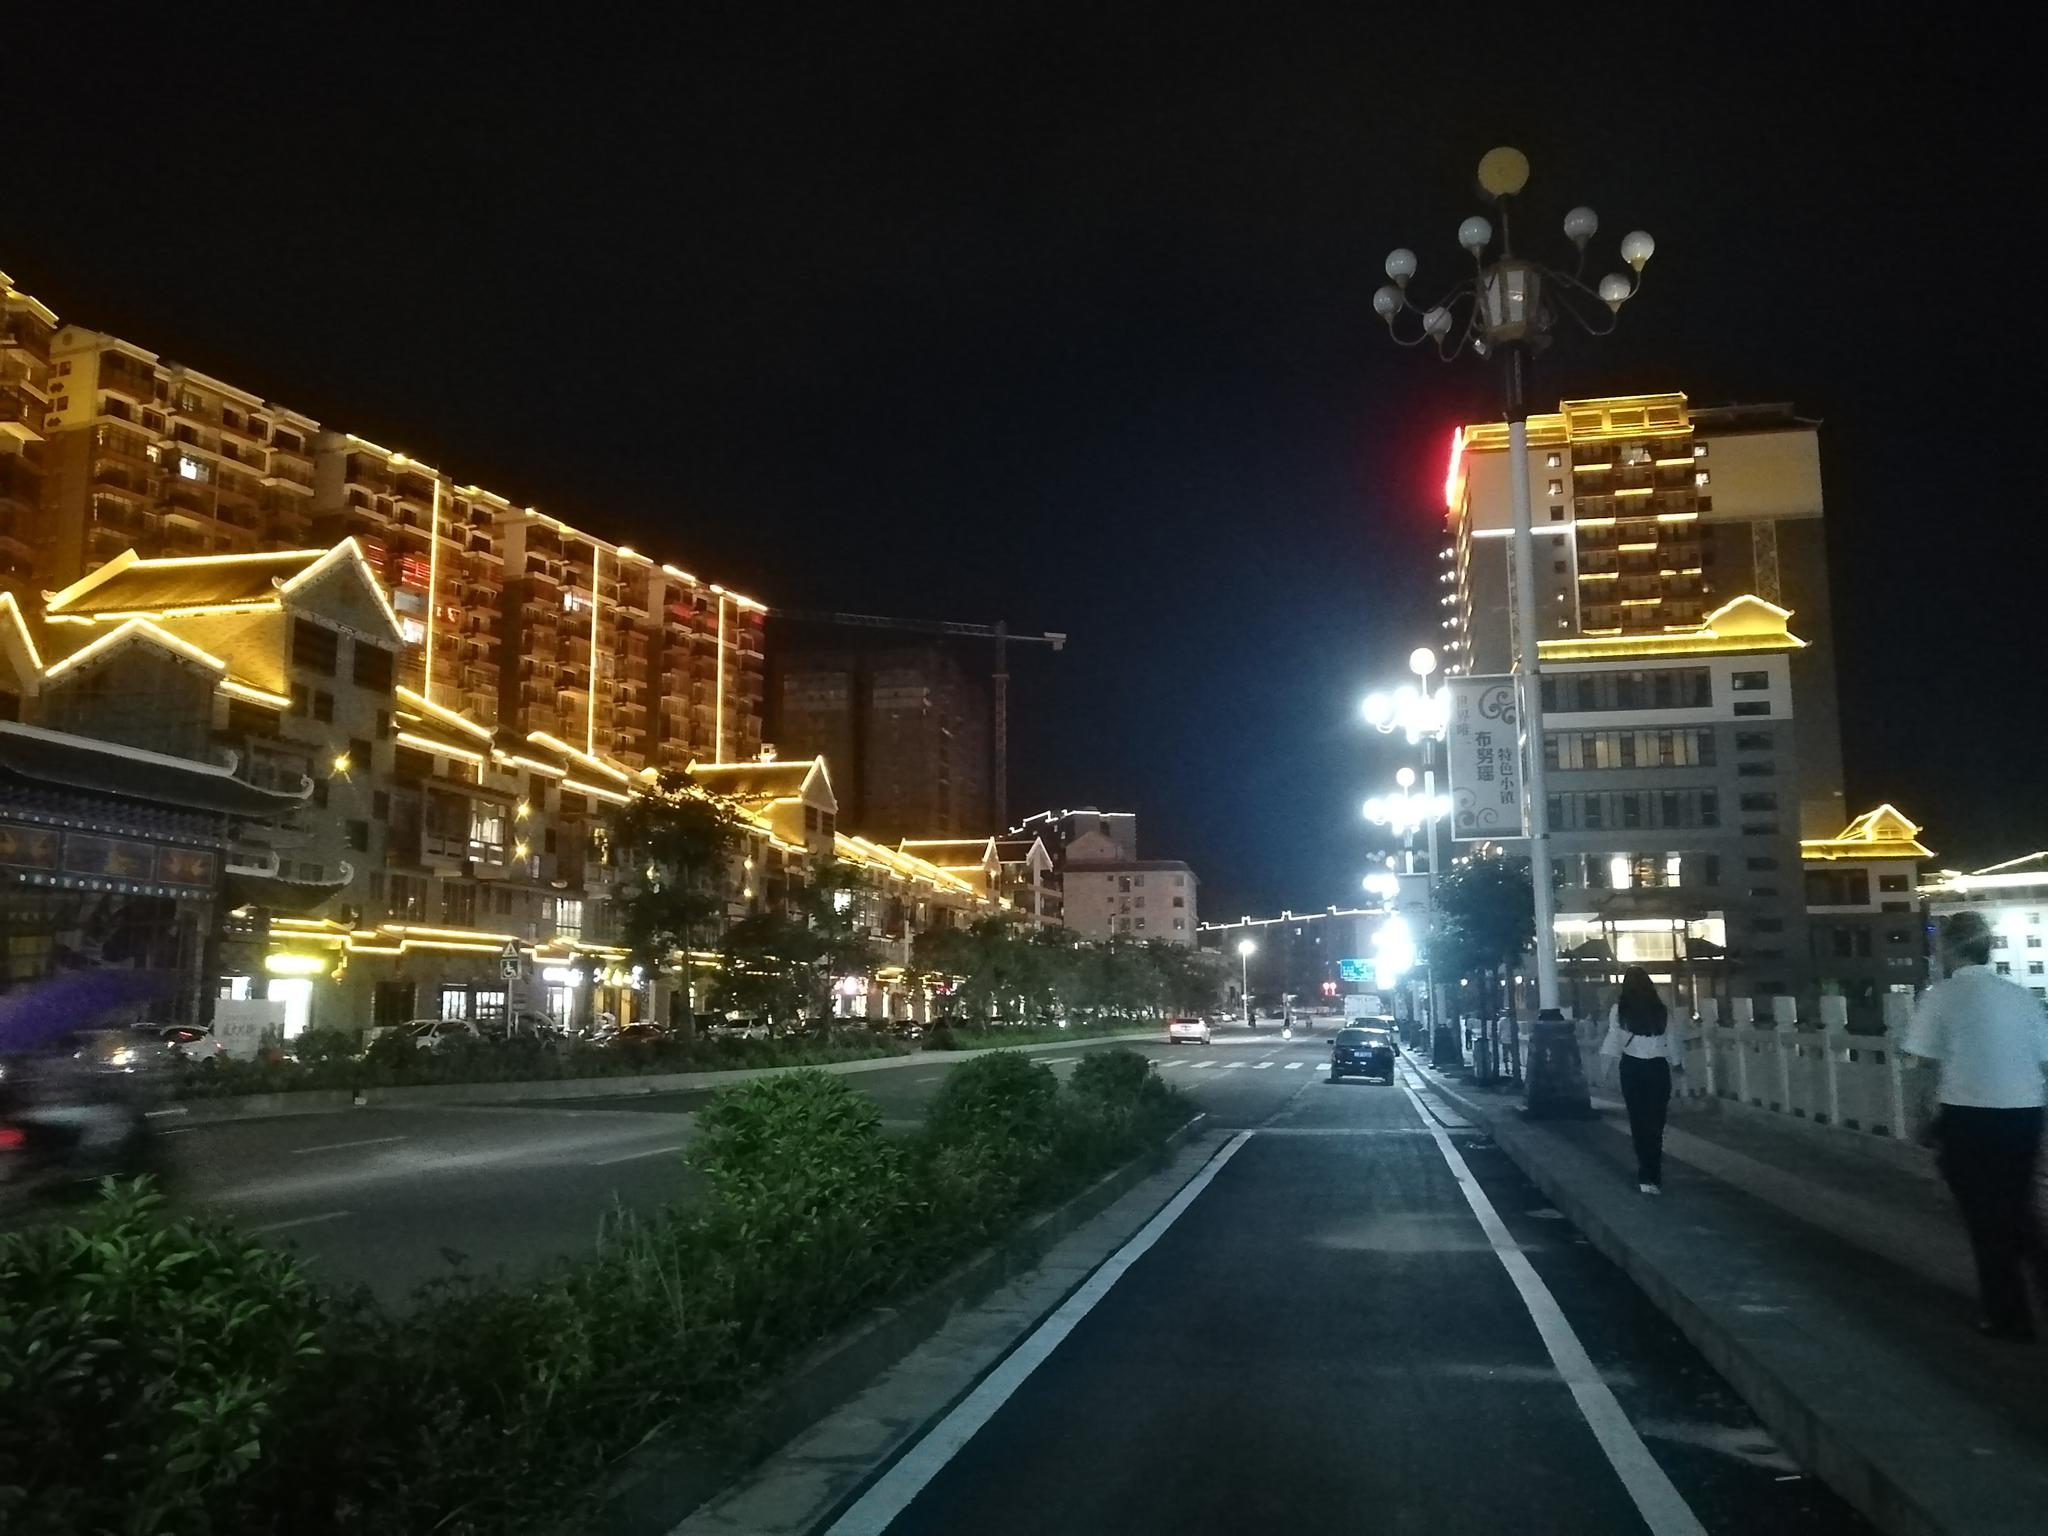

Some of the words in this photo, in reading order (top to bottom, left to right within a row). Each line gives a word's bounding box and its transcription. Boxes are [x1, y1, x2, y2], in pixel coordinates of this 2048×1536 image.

[1475, 731, 1495, 781] 布努瑶
[1498, 746, 1514, 804] 特色小镇
